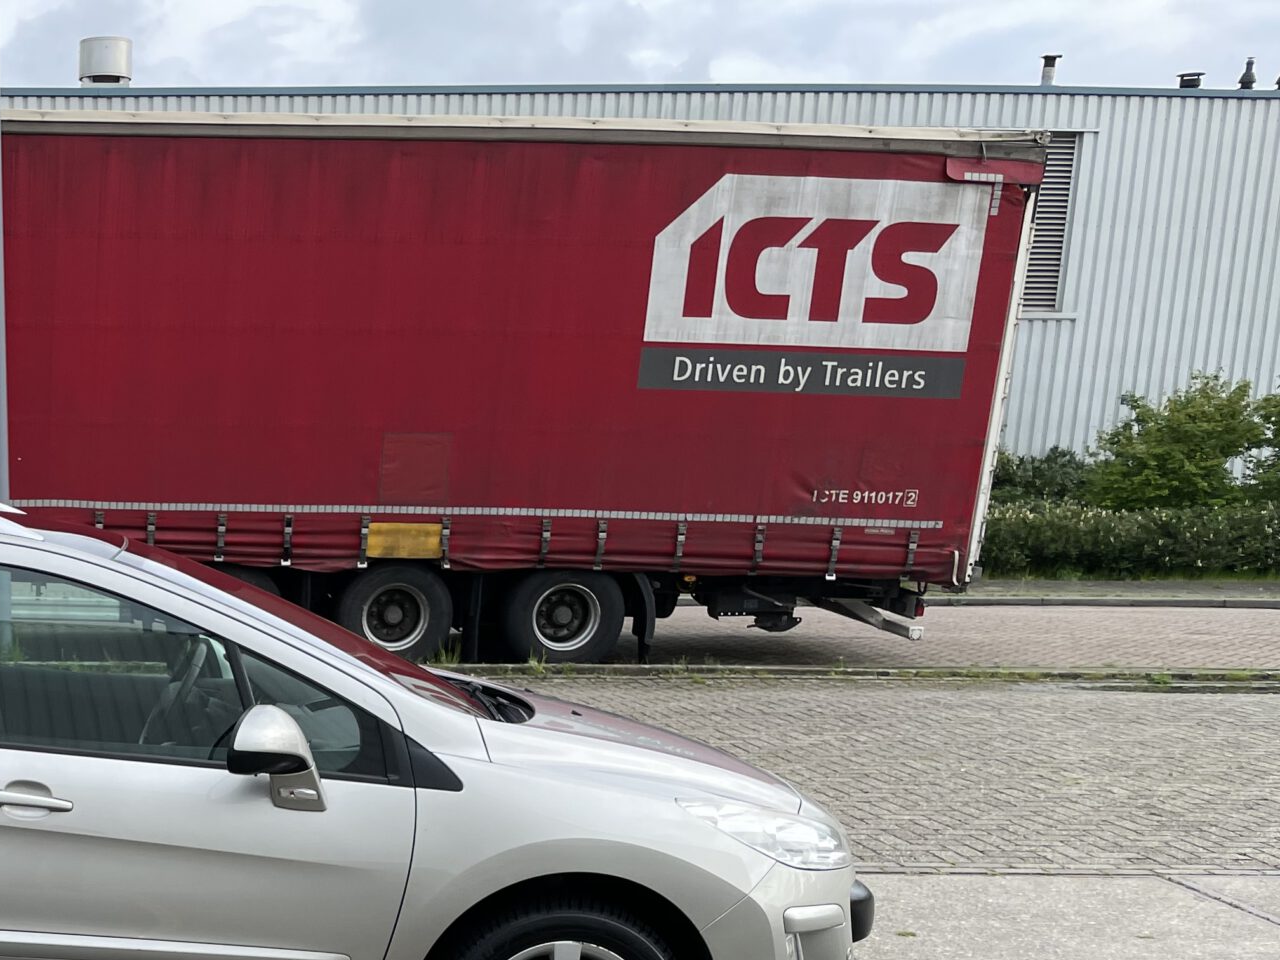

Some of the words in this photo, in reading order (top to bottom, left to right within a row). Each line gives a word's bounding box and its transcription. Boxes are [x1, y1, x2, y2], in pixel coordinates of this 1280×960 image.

[682, 214, 961, 325] ICTS
[672, 355, 766, 385] Driven
[777, 358, 812, 392] by
[821, 360, 926, 390] Trailers
